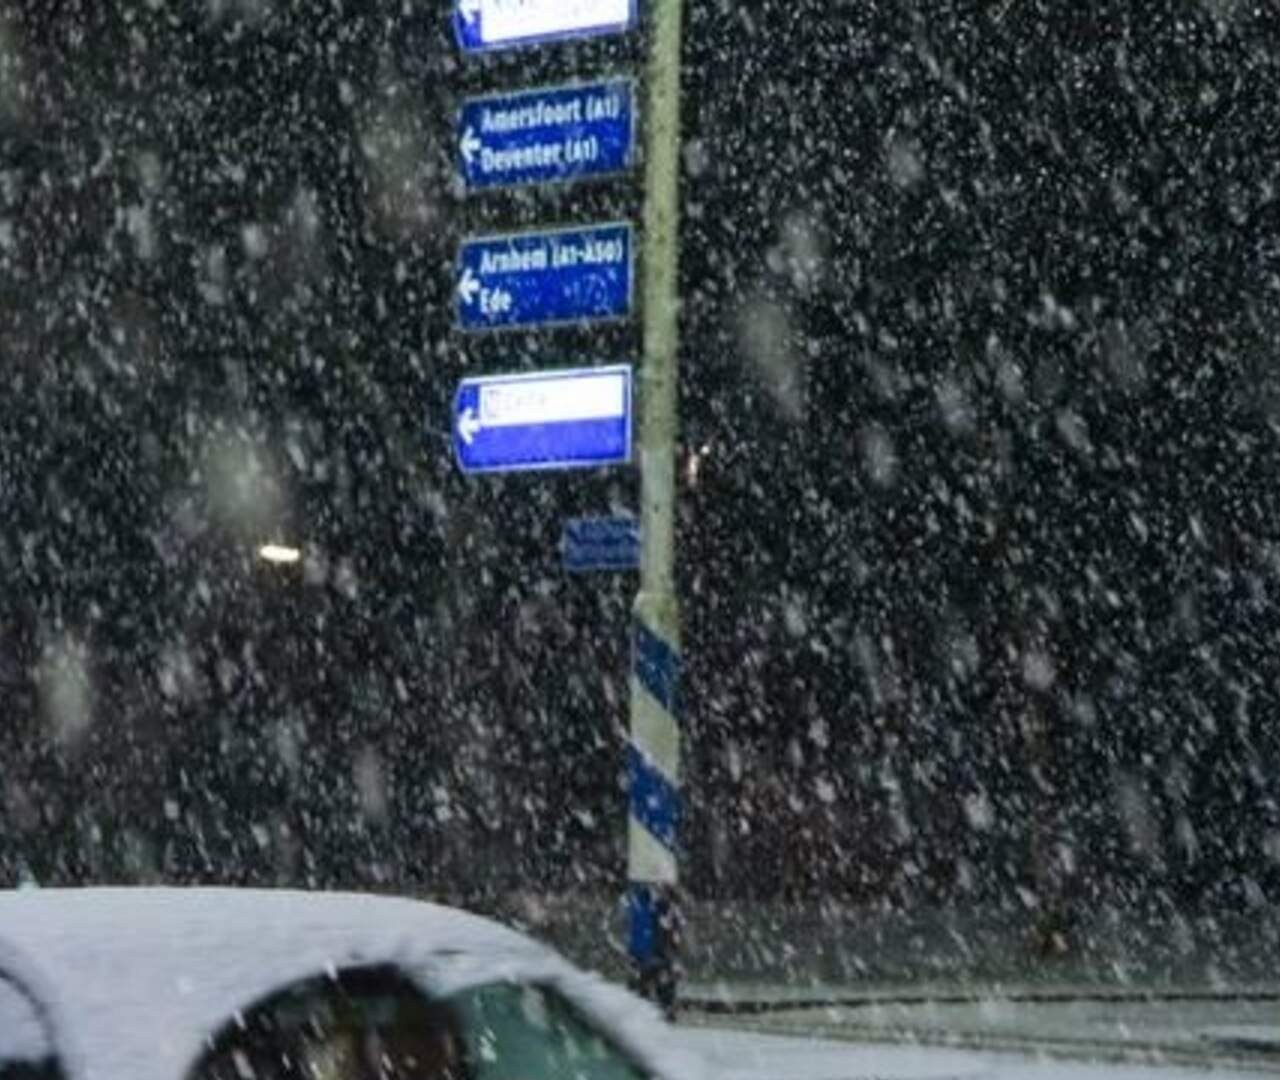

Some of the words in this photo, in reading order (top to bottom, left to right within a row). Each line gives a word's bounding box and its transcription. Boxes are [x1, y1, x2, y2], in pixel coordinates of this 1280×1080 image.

[481, 97, 582, 132] Amersfoort
[480, 143, 563, 172] Deventer
[480, 245, 549, 275] Arnhem
[479, 288, 512, 314] Ede
